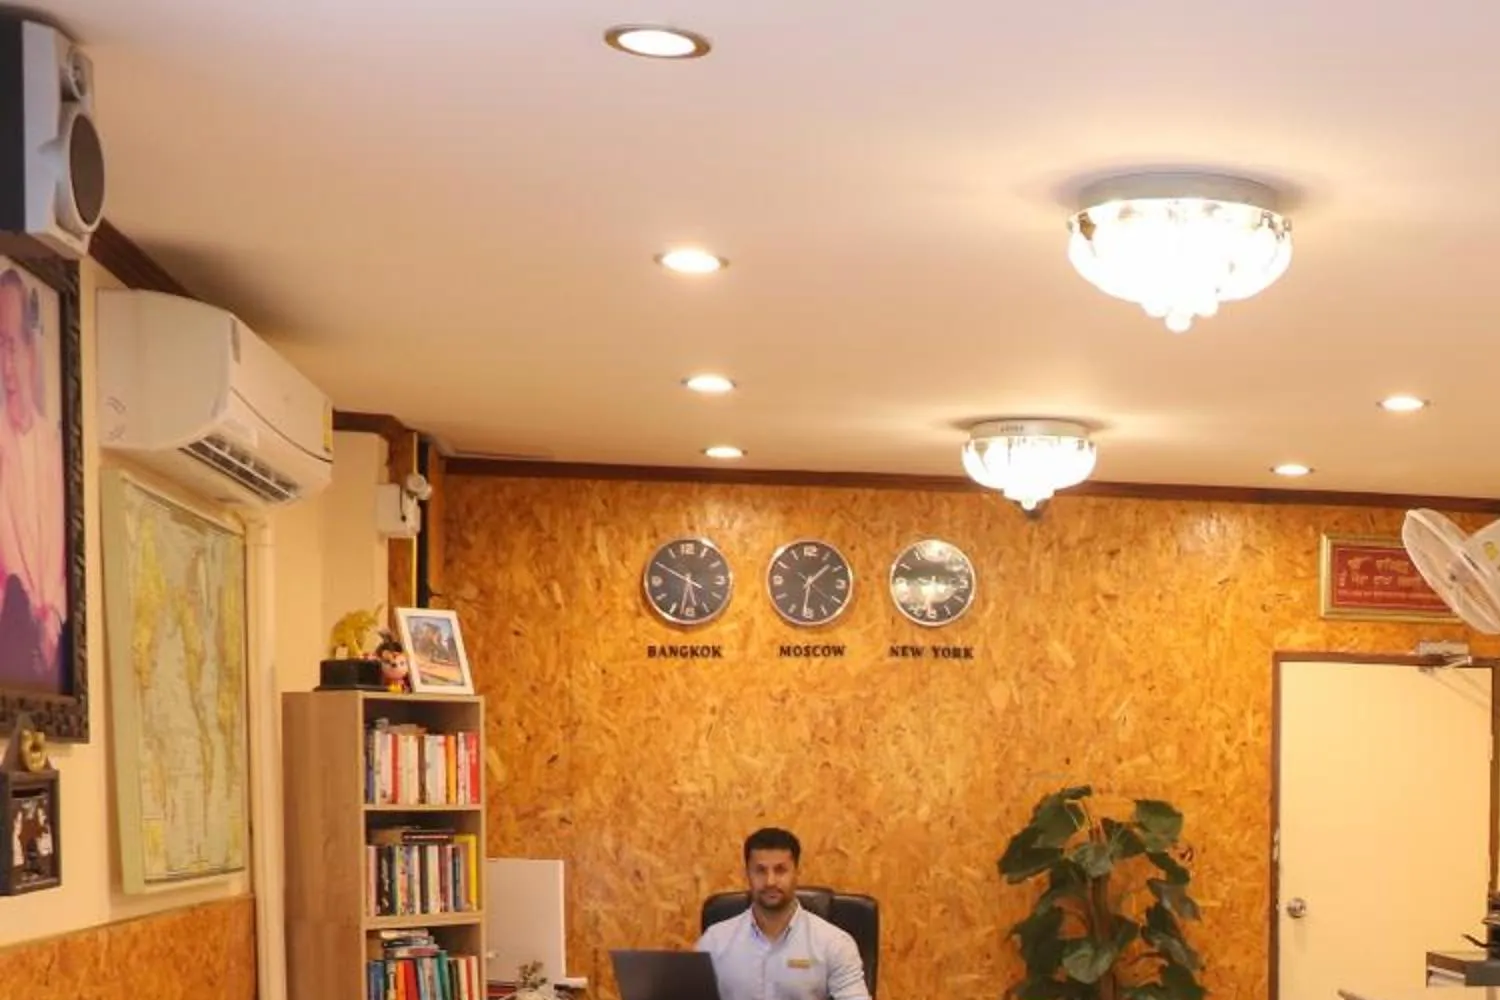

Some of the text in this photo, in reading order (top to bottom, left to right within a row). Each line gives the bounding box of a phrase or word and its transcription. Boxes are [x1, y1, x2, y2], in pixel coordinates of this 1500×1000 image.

[647, 645, 723, 659] BANGKOK
[778, 645, 847, 658] MOSCOW
[889, 645, 975, 659] NEW YORK
